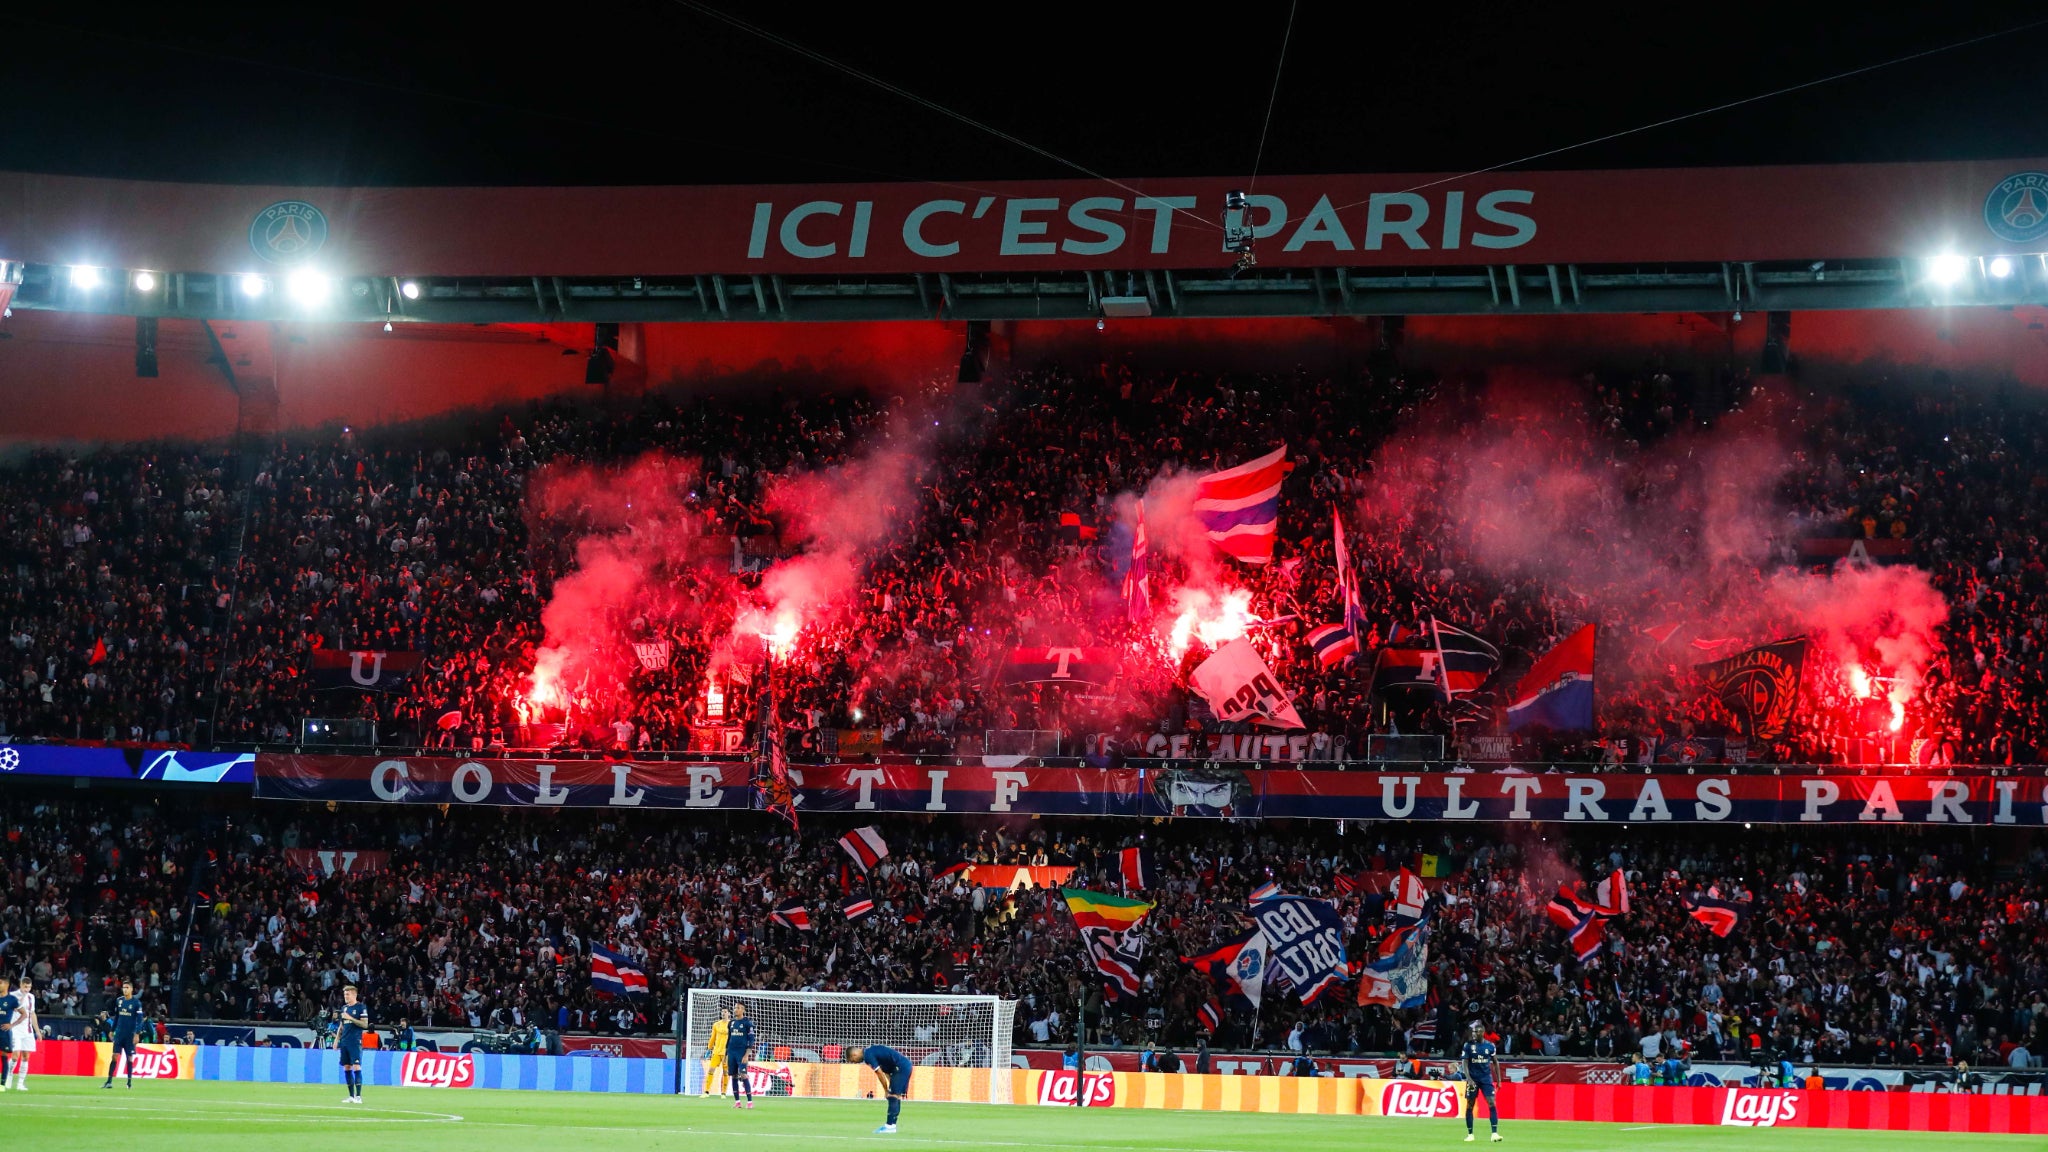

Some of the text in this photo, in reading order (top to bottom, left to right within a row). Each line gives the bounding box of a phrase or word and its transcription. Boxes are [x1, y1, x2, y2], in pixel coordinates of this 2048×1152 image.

[266, 204, 315, 220] PARIS
[747, 189, 1537, 259] ICI C'EST PARIS
[349, 651, 387, 686] U
[1045, 647, 1084, 678] T
[1378, 776, 1732, 821] ULTRAS
[1800, 779, 2048, 825] PARI
[403, 1052, 471, 1087] Lay's
[1039, 1069, 1112, 1107] Lay's
[1388, 1083, 1454, 1117] Lay's
[1721, 1087, 1799, 1126] Lay's
